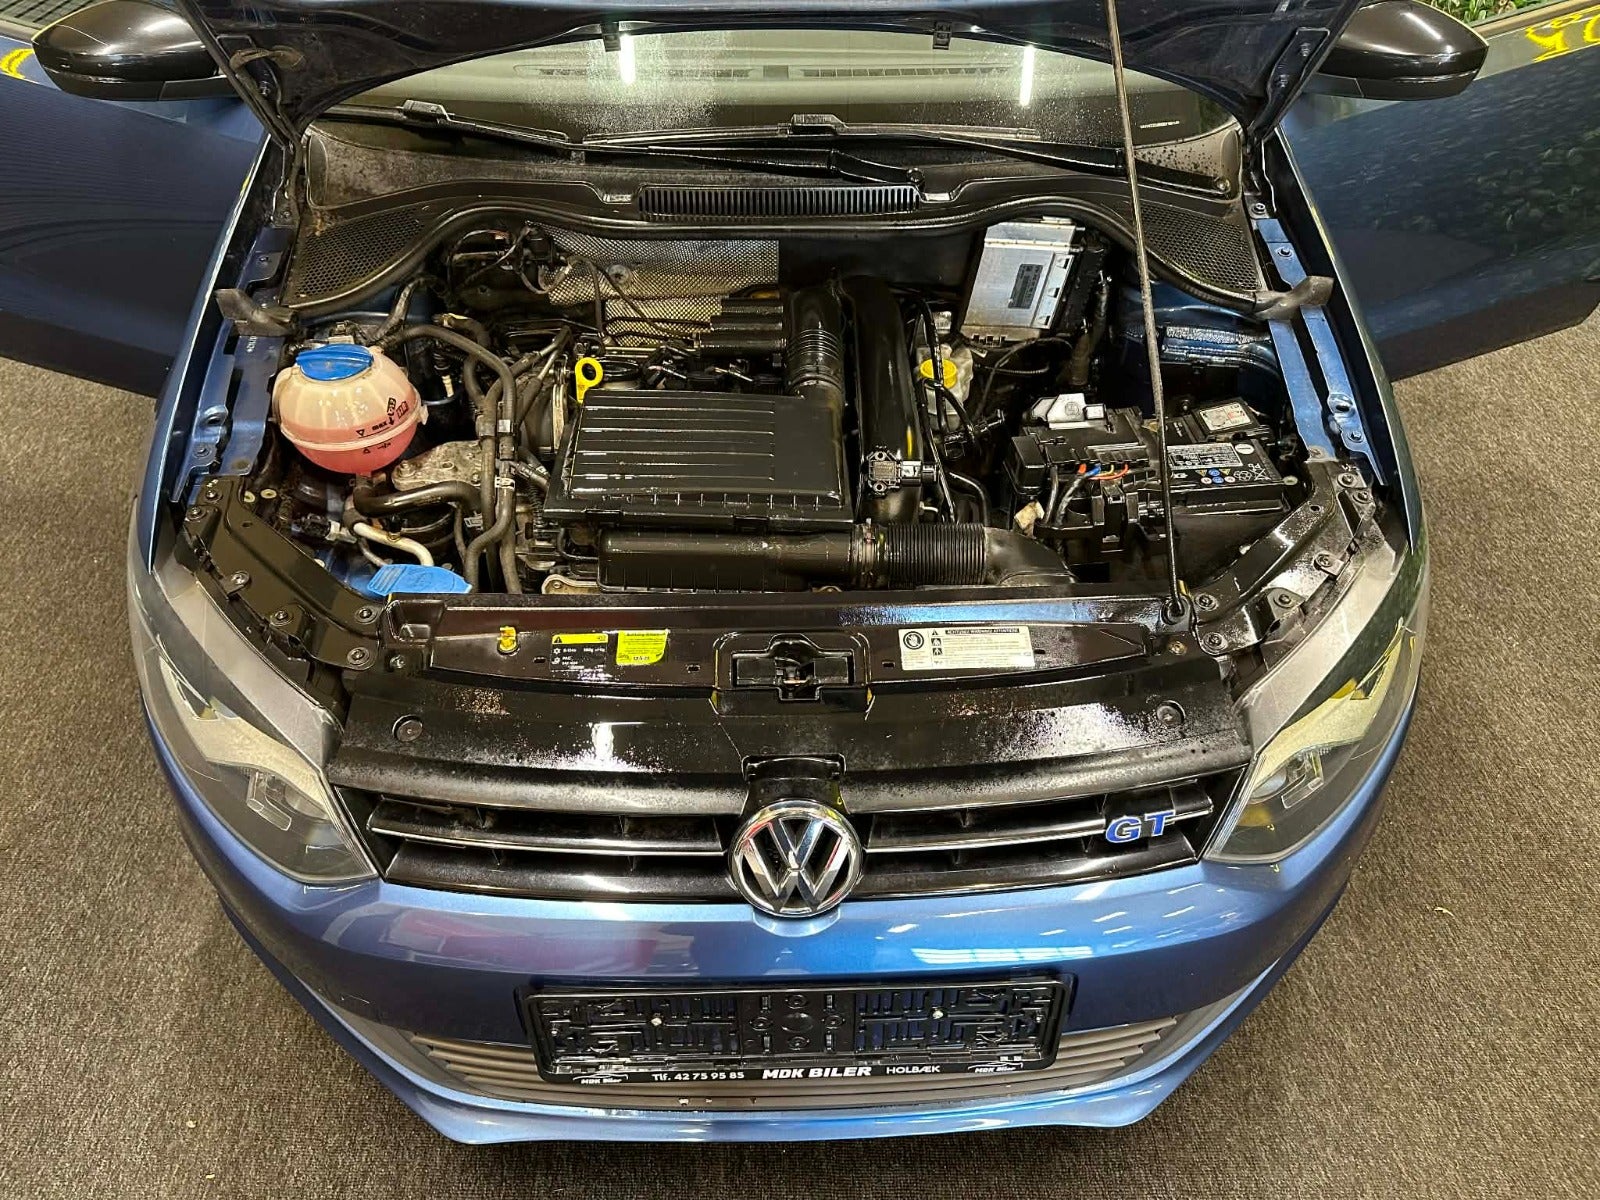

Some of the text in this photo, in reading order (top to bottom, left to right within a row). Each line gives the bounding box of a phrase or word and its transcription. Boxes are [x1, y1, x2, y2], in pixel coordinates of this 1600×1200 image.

[1105, 811, 1176, 844] GT
[762, 1067, 872, 1079] MDK BILER
[886, 1065, 941, 1074] HOLBÆK
[652, 1073, 670, 1081] Tlf.
[675, 1073, 690, 1081] 42
[711, 1072, 726, 1080] 95
[729, 1072, 745, 1080] 85
